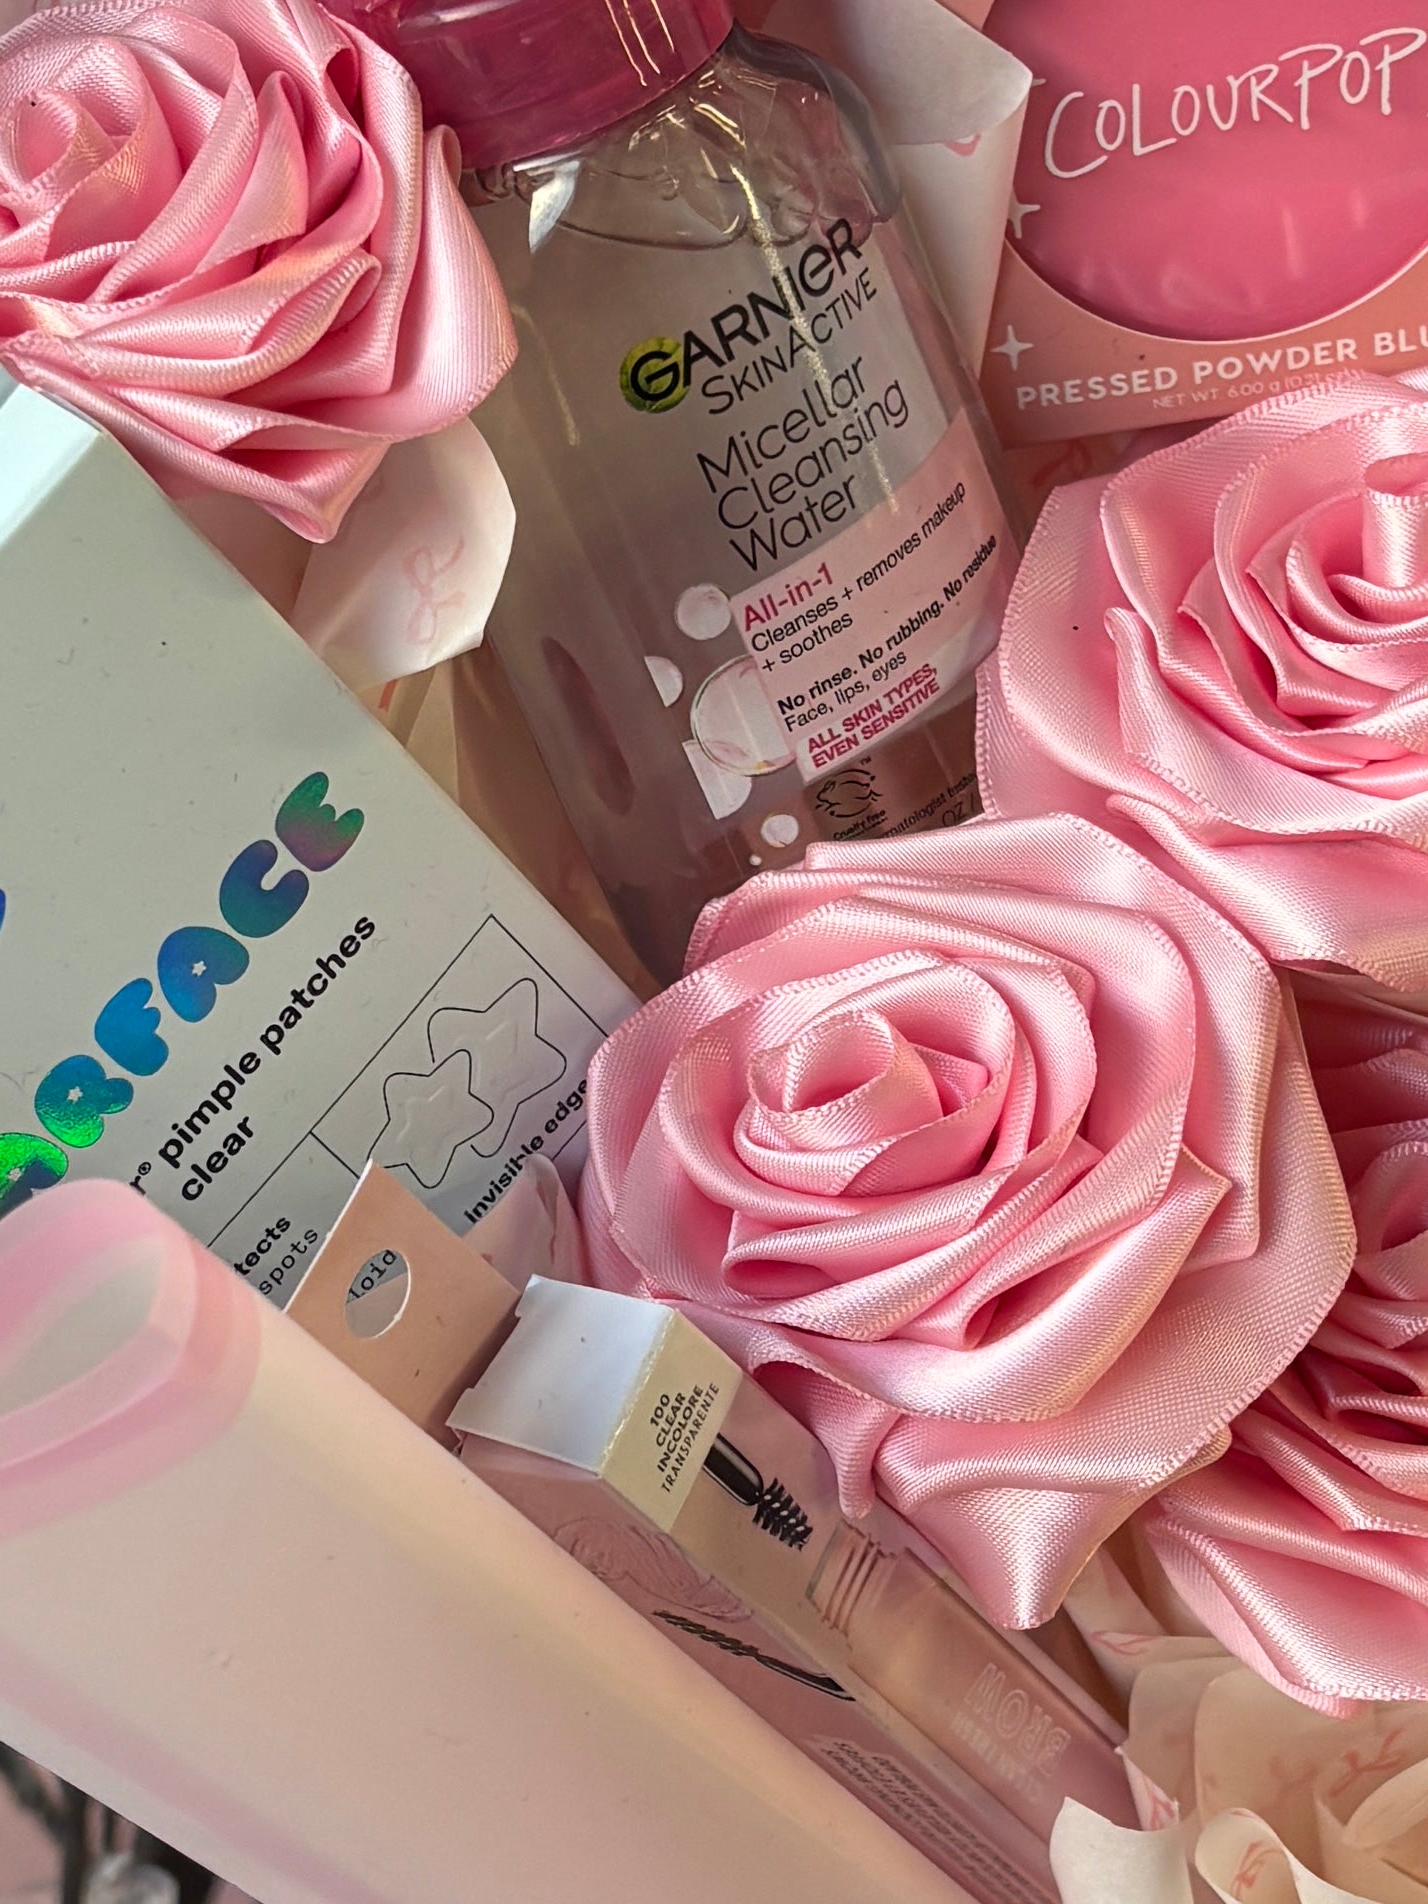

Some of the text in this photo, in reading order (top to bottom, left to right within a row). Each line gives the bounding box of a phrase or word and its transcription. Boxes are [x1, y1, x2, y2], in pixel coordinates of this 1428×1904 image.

[1044, 27, 1427, 179] COLOURPOP
[1016, 365, 1178, 410] PRESSED
[1192, 337, 1359, 385] POWDER
[1152, 394, 1188, 409] NET
[696, 356, 863, 493] Micellar
[718, 380, 909, 530] Cleansing
[729, 473, 855, 572] Water
[751, 596, 839, 652] Cleanses
[856, 532, 922, 592] removes
[921, 482, 966, 539] makeup
[745, 562, 834, 632] All-in-1
[777, 535, 997, 716] No rinse. No rubbing. No residue
[779, 612, 853, 665] soothes
[785, 650, 907, 732] Face, lips, eyes
[808, 663, 937, 754] ALL SKIN TYPES,
[812, 679, 941, 768] EVEN SENSITIVE
[158, 916, 376, 1169] pimple patches
[181, 1116, 255, 1201] clear
[650, 1394, 670, 1427] 100
[656, 1392, 686, 1448] CLEAR
[657, 1385, 704, 1473] INCOLORE
[661, 1382, 720, 1493] TRANSPARENTE
